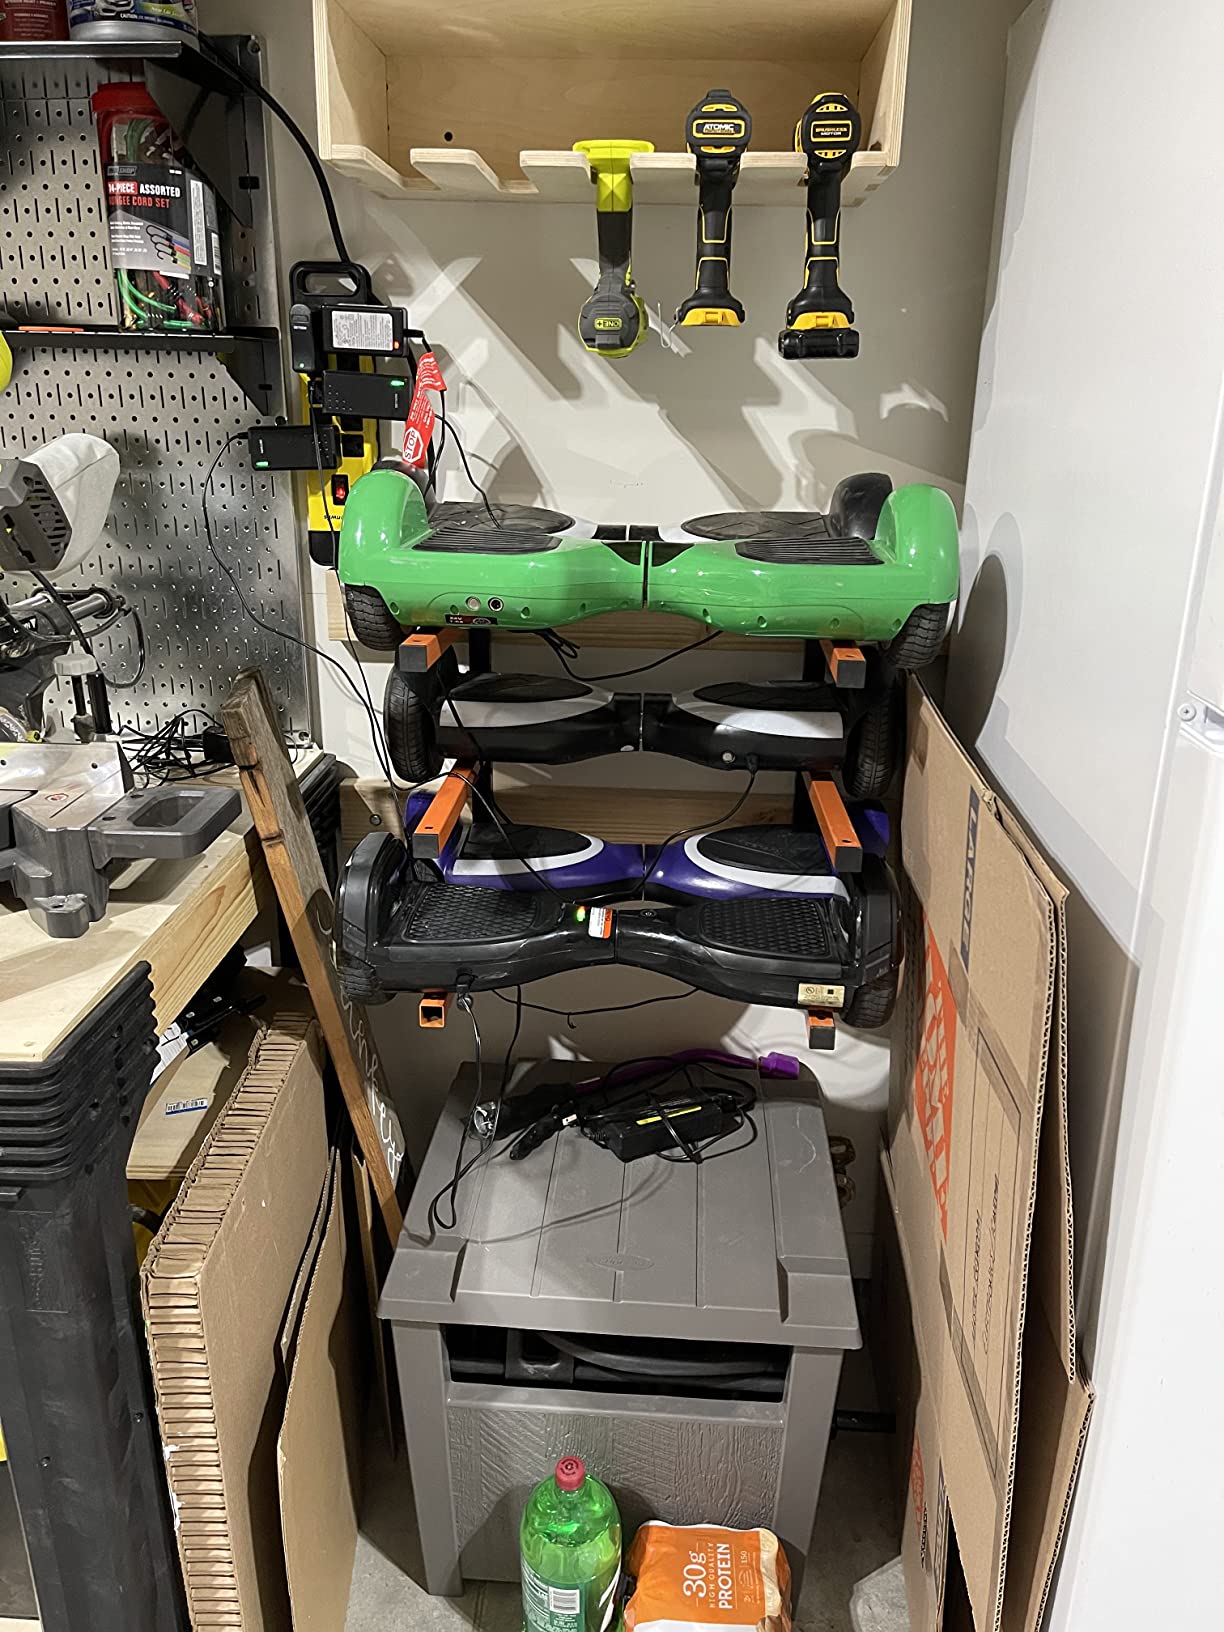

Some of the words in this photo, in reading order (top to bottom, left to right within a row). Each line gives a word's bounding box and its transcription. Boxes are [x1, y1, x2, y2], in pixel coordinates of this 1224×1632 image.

[132, 196, 153, 208] CORD
[155, 198, 171, 209] SET
[139, 183, 181, 198] ASSORTED
[404, 430, 417, 460] STOP
[961, 806, 977, 952] LARGE
[682, 1551, 707, 1598] 30g
[707, 1542, 716, 1580] QUALITY
[716, 1543, 733, 1609] PROTEIN
[708, 1583, 716, 1608] HIGH
